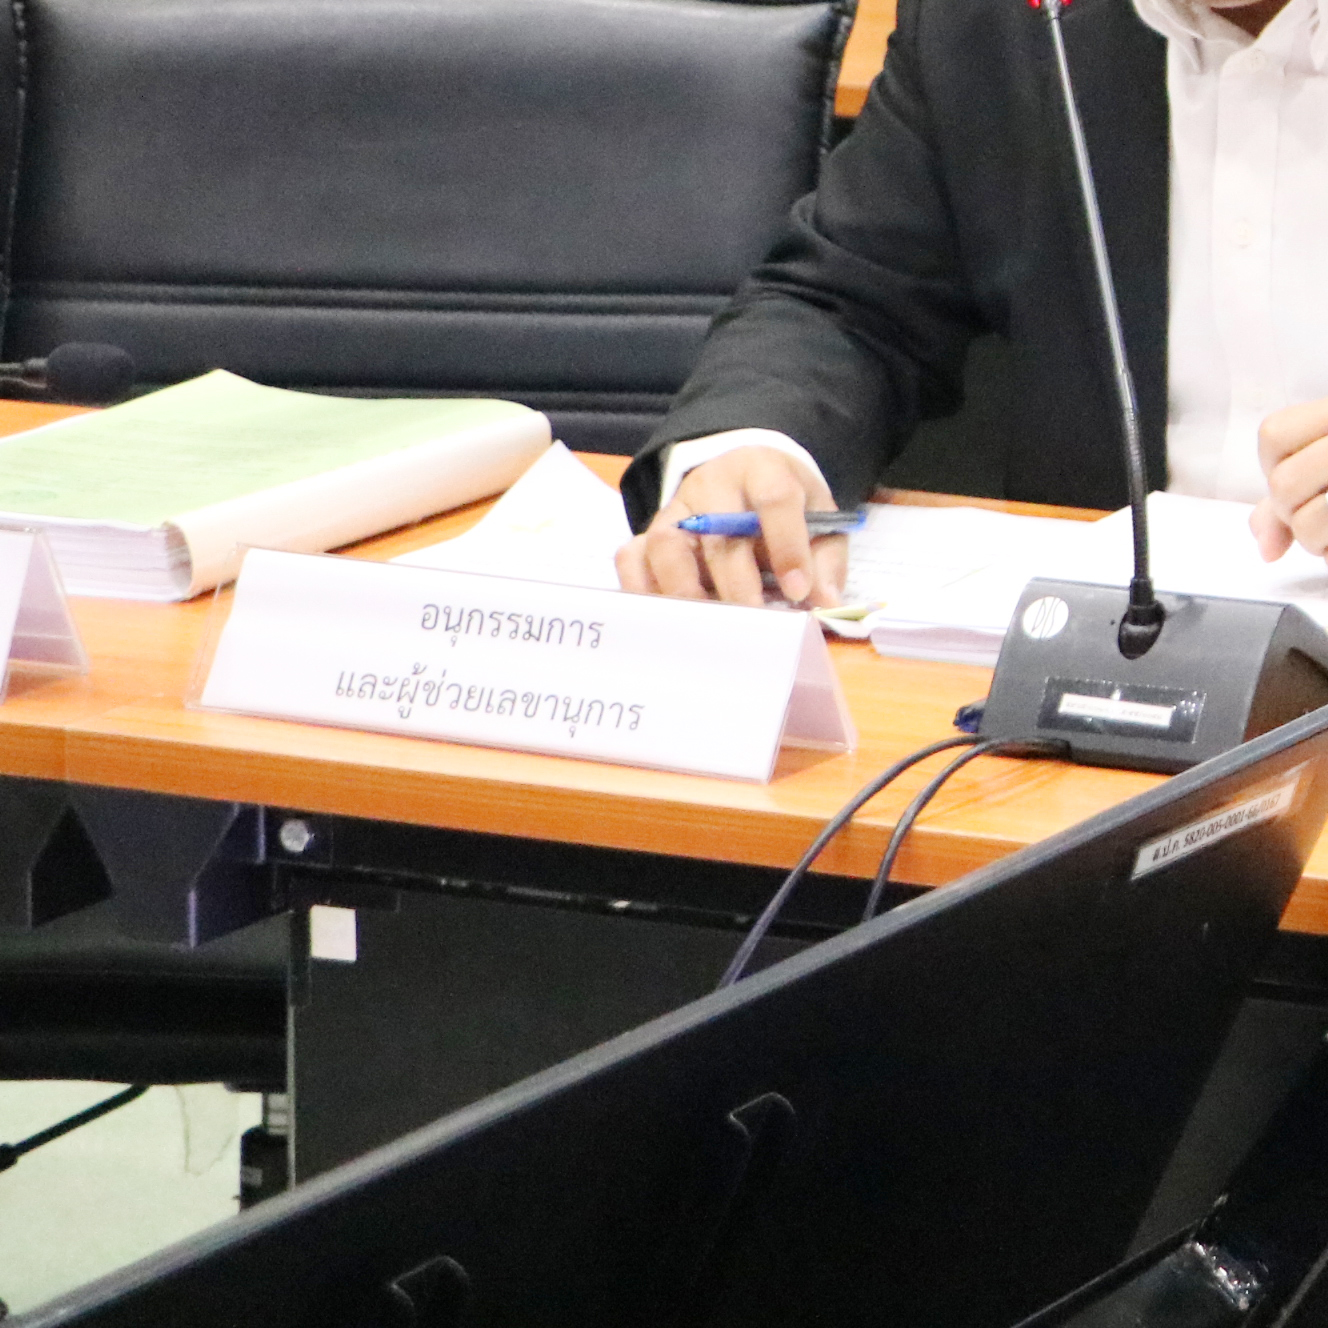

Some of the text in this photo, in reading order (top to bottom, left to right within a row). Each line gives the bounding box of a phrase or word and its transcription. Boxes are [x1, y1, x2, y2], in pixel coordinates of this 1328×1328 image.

[420, 602, 604, 648] อนุกรรมการ
[335, 662, 645, 738] และผู้ช่วยเลขานุการ
